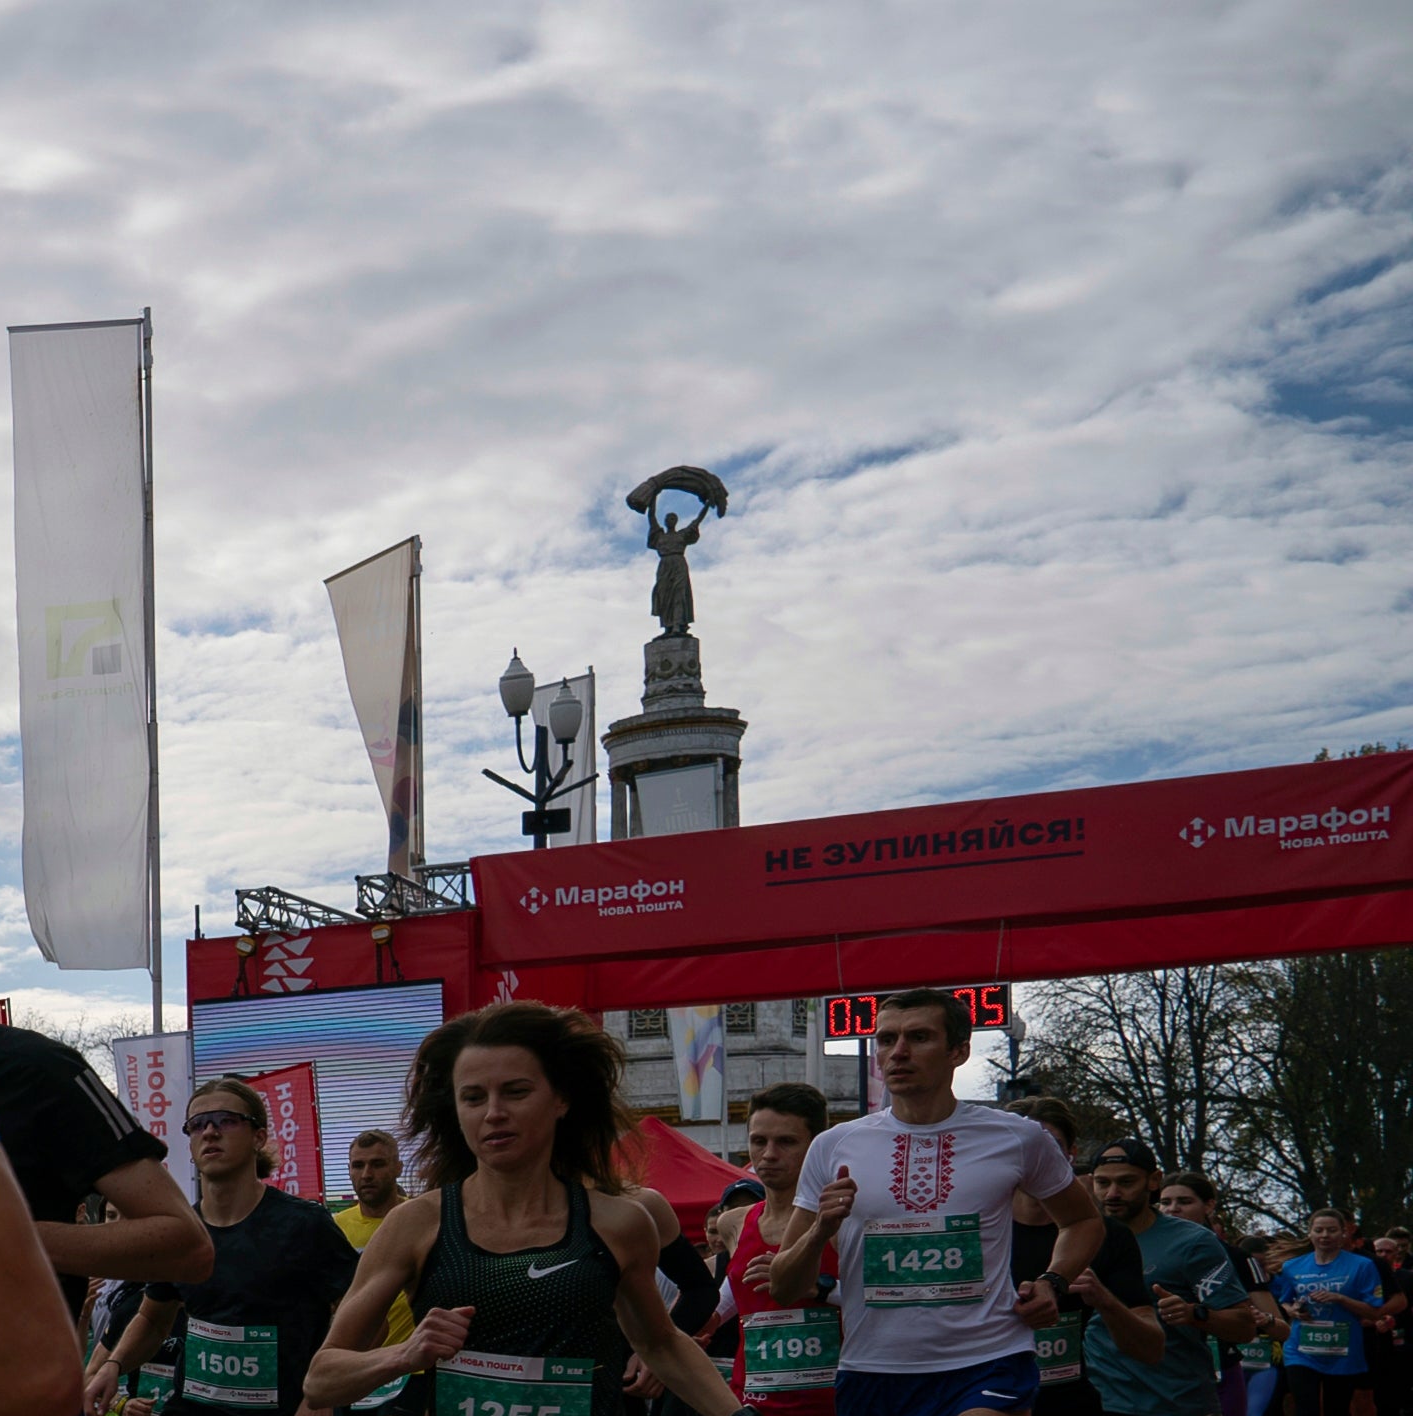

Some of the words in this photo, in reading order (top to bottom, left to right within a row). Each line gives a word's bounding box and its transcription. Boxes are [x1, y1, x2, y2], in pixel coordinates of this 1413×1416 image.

[1224, 805, 1391, 838] Марафон
[765, 846, 811, 872] НЕ
[823, 817, 1085, 866] ЗУПИНЯЙСЯ!
[1279, 836, 1325, 850] НОВА
[1328, 829, 1390, 845] ПОШТА
[555, 879, 685, 906] Марафон
[598, 906, 634, 917] НОВА
[636, 900, 684, 914] ПОШТА
[882, 1247, 964, 1272] 1428
[756, 1337, 822, 1360] 1198
[1037, 1338, 1067, 1358] 80
[197, 1350, 260, 1377] 1505
[460, 1356, 484, 1368] НОВА
[486, 1361, 524, 1372] ПОШТА
[550, 1364, 564, 1375] 10
